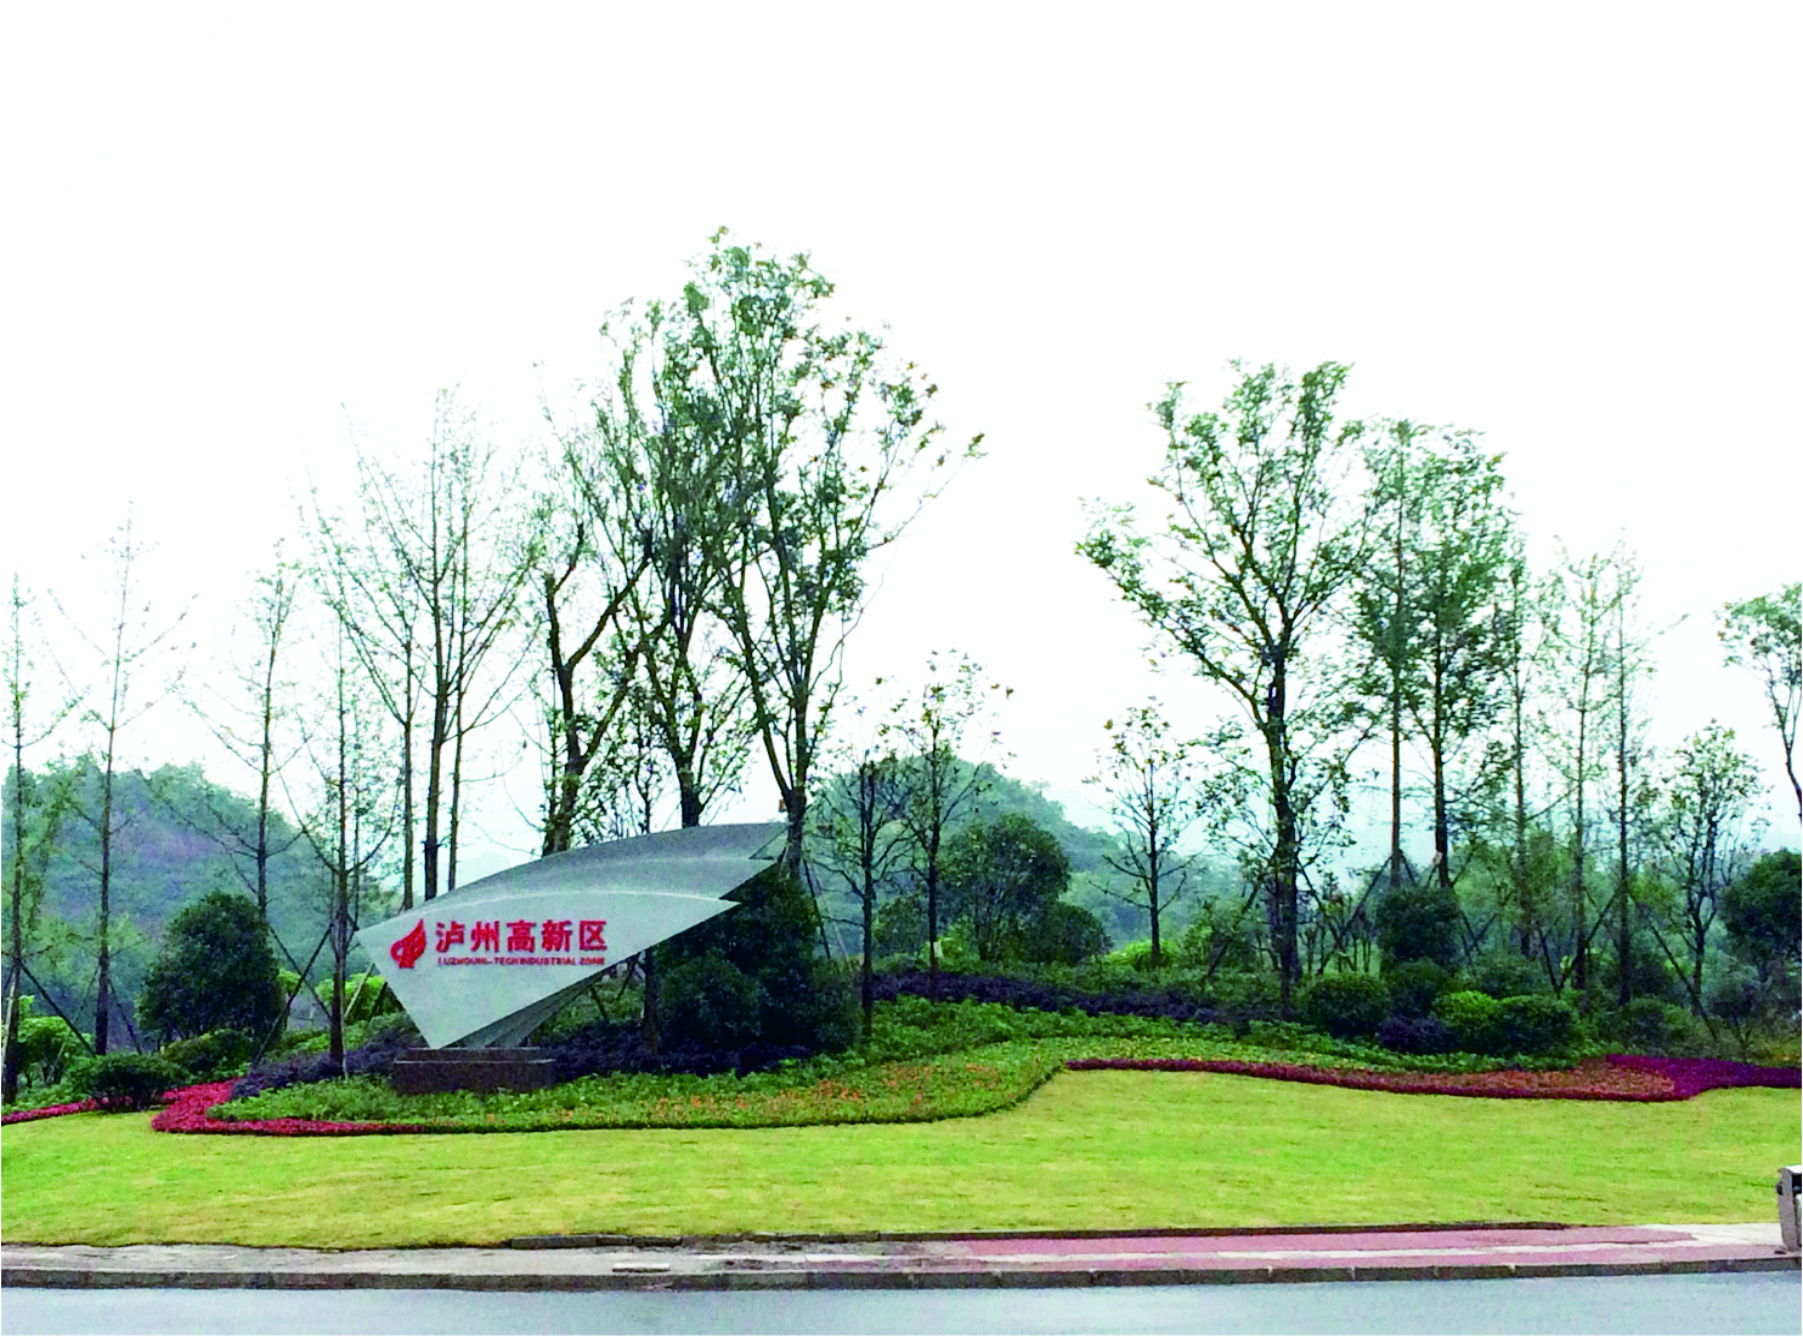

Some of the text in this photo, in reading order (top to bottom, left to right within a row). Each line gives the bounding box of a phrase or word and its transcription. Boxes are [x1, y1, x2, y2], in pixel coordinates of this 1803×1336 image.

[435, 919, 607, 953] 泸州高新区
